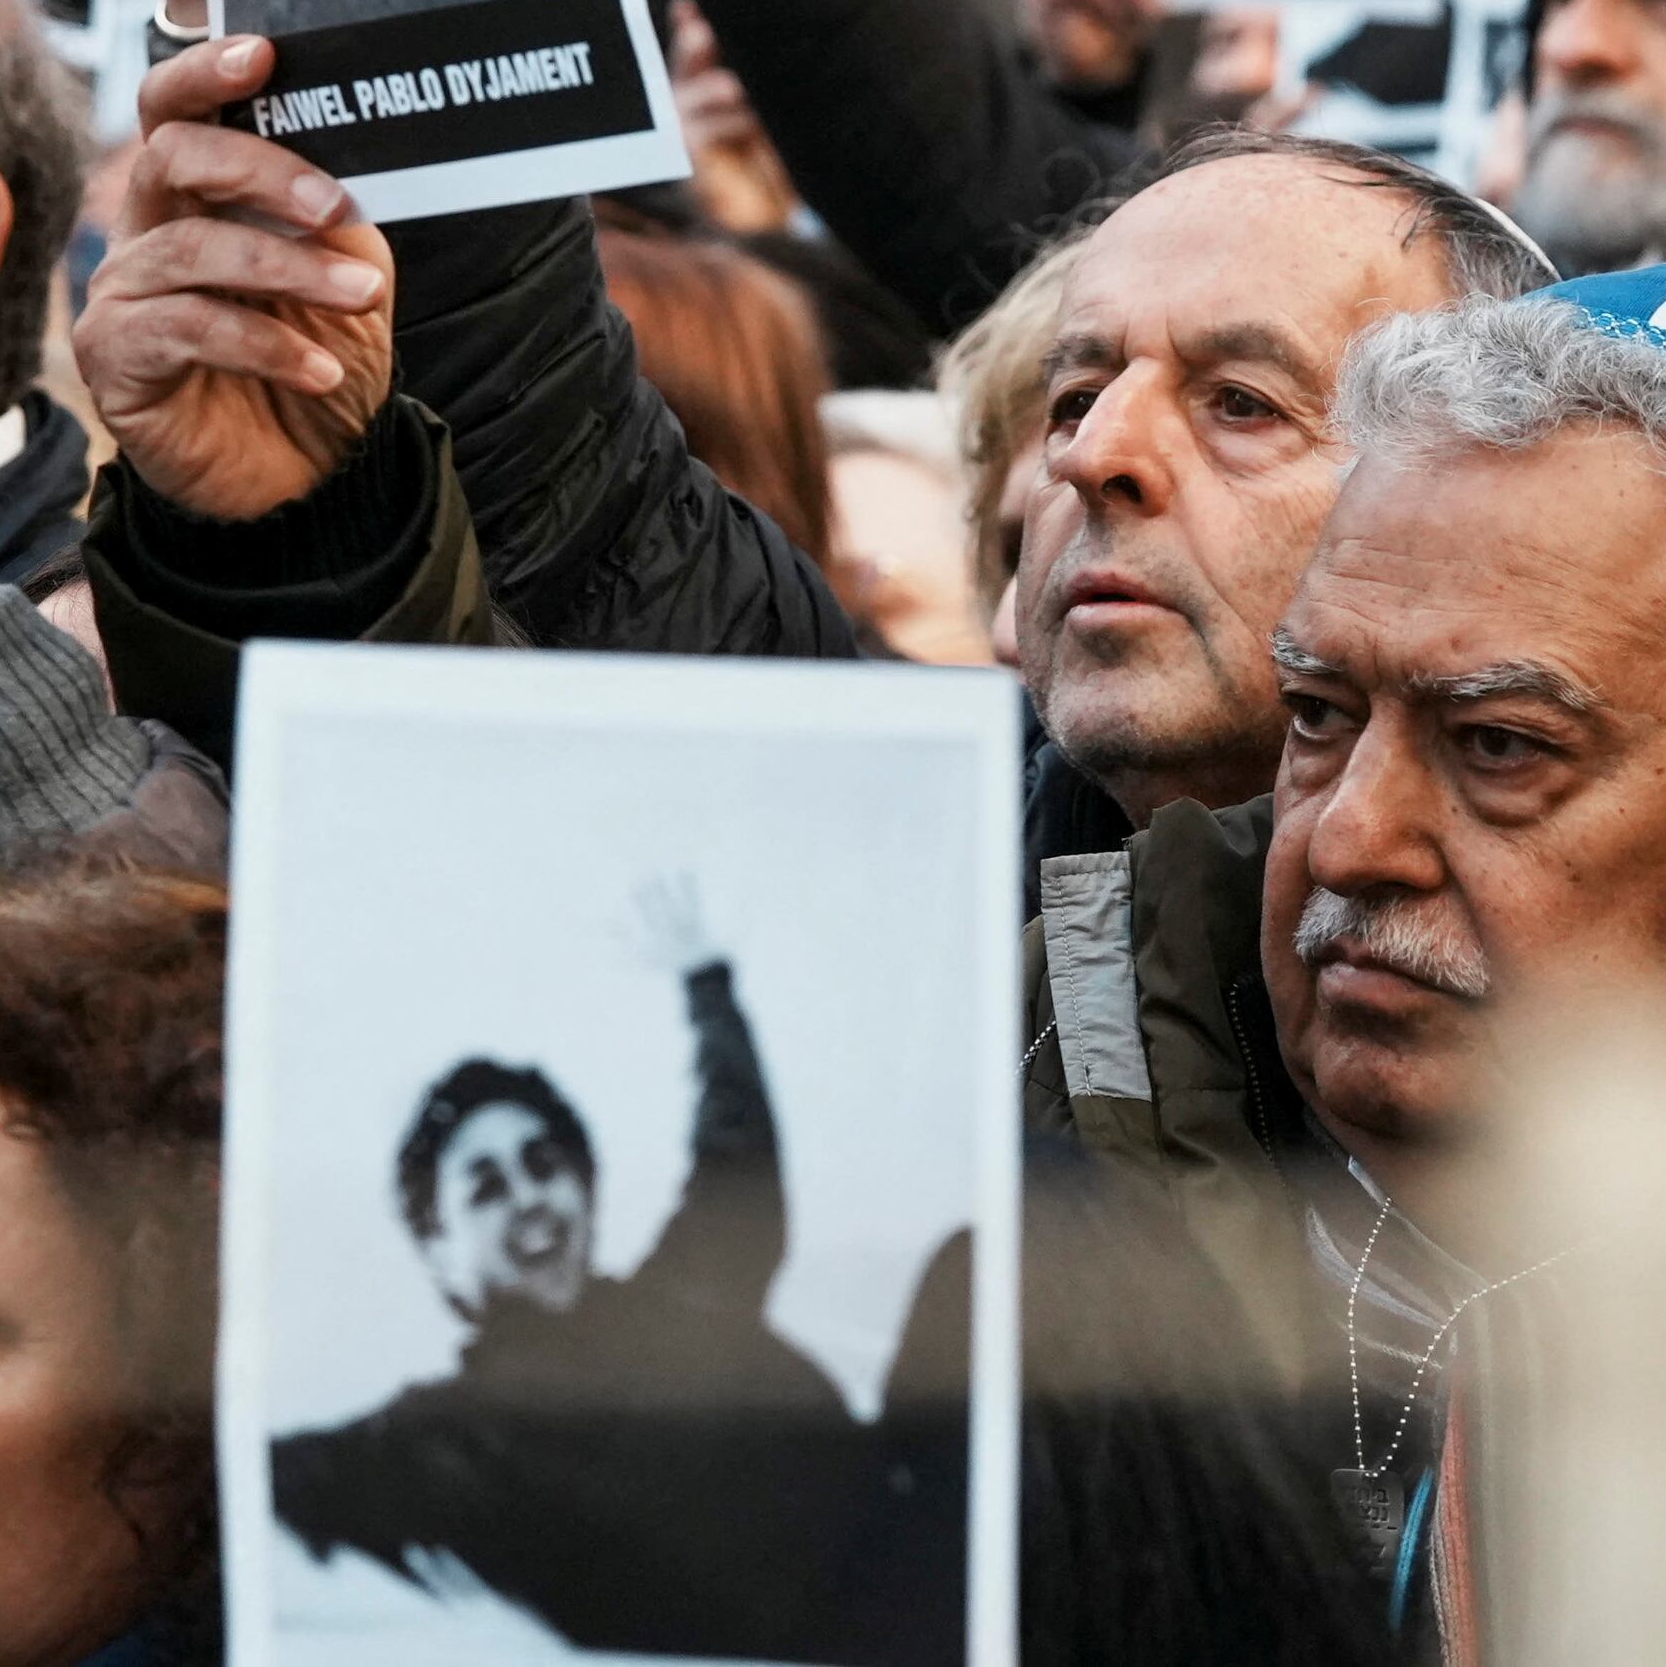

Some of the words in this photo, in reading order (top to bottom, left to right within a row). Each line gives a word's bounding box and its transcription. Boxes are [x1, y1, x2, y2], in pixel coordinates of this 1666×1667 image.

[252, 84, 357, 137] FAIWEL
[354, 66, 445, 120] PABLO
[444, 41, 595, 106] DYJAMENT
